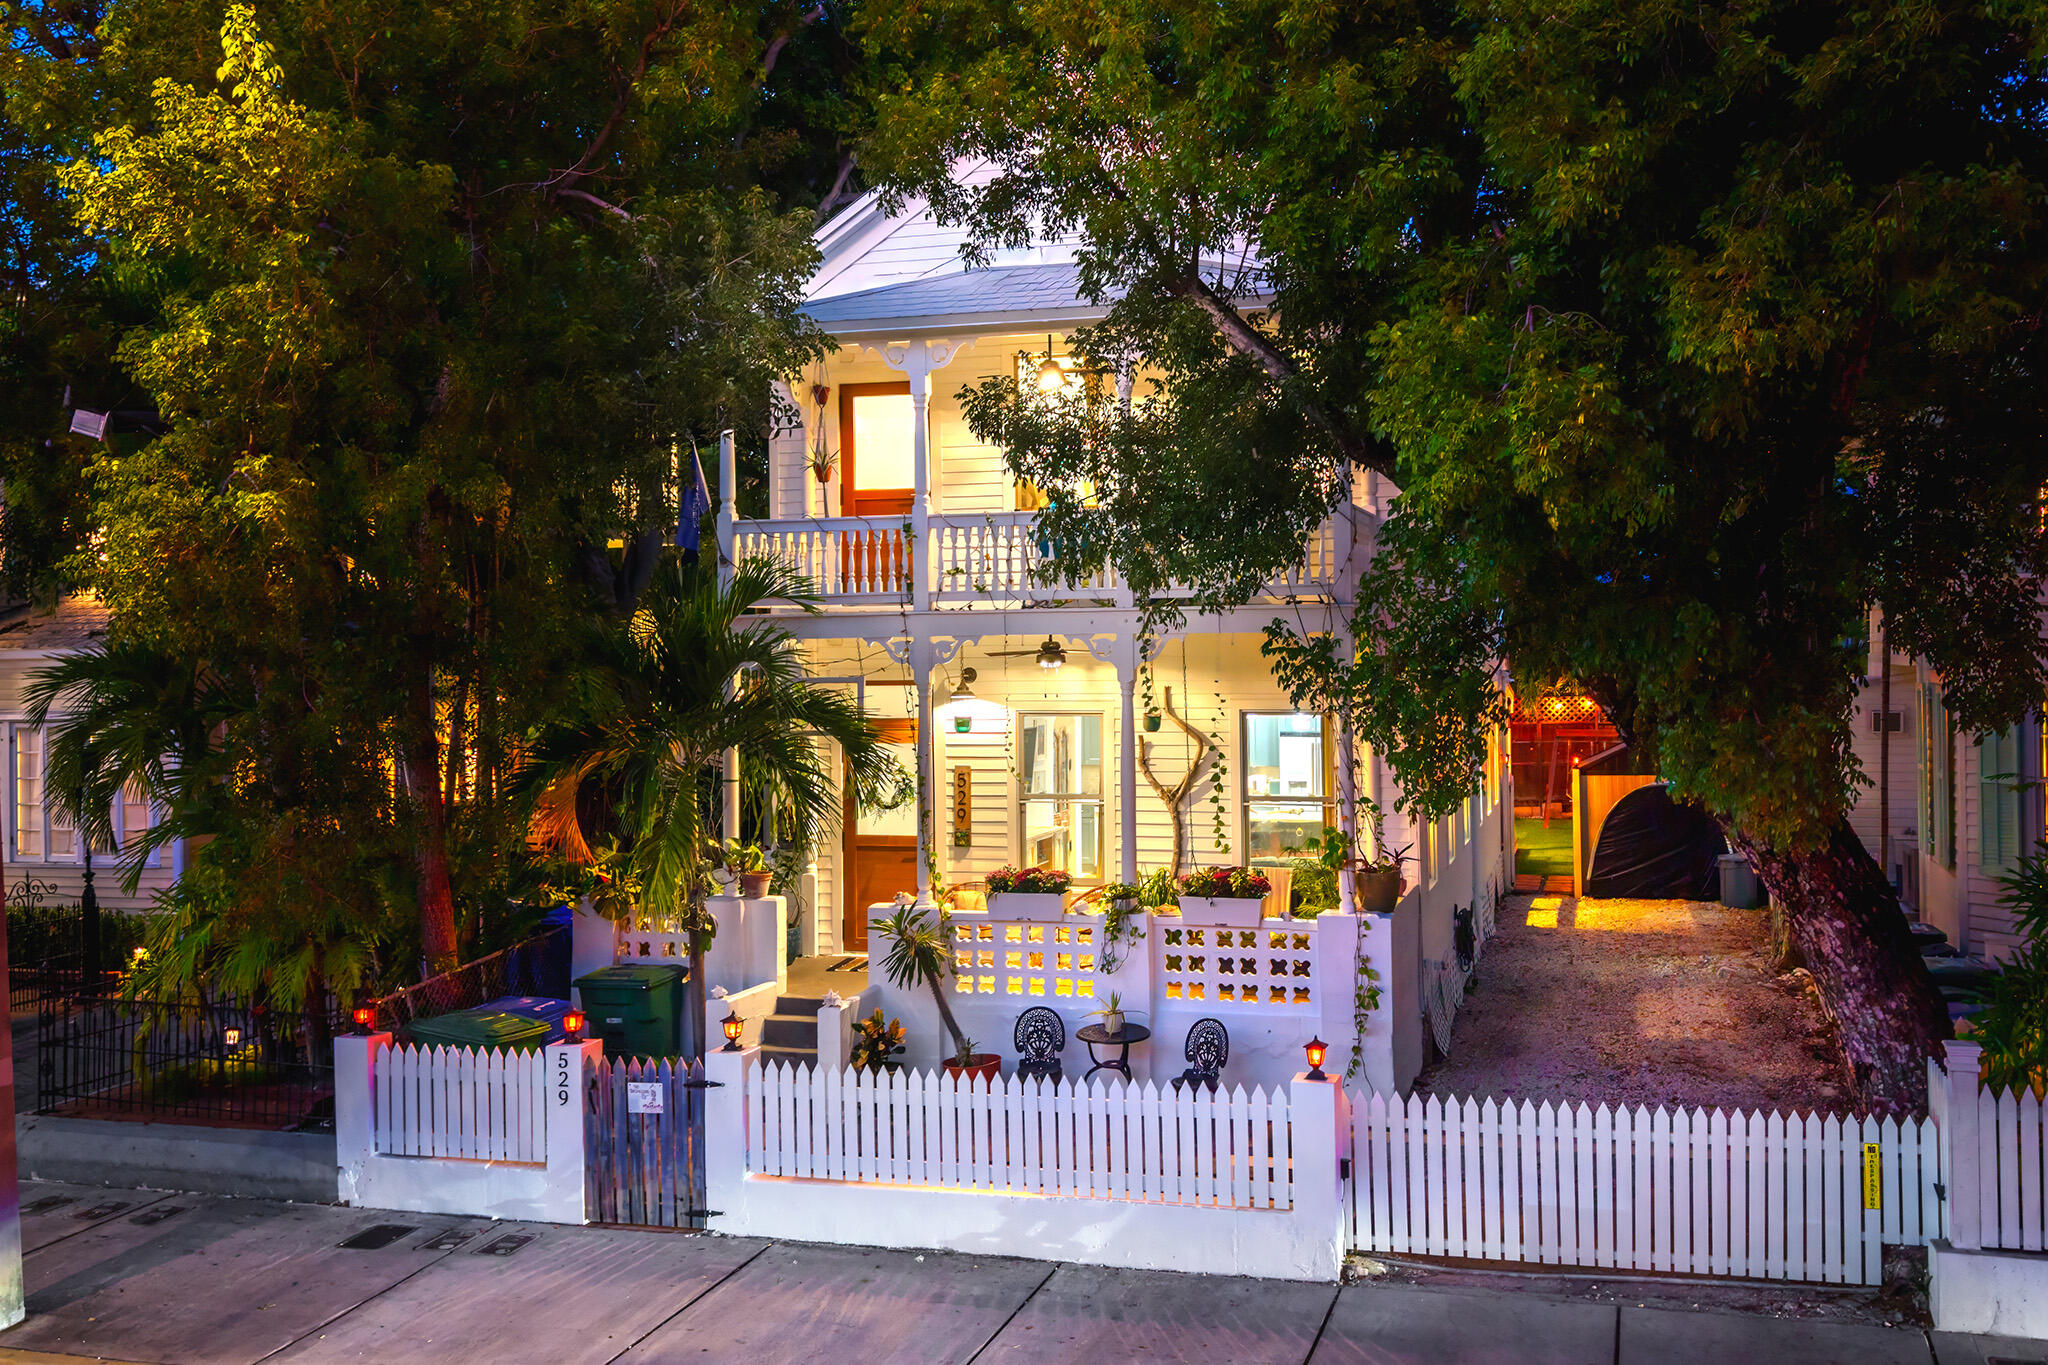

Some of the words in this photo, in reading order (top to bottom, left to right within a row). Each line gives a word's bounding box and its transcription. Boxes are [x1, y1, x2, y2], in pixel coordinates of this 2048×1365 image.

[957, 772, 967, 824] 529
[558, 1052, 569, 1106] 529
[1867, 1146, 1876, 1154] NO
